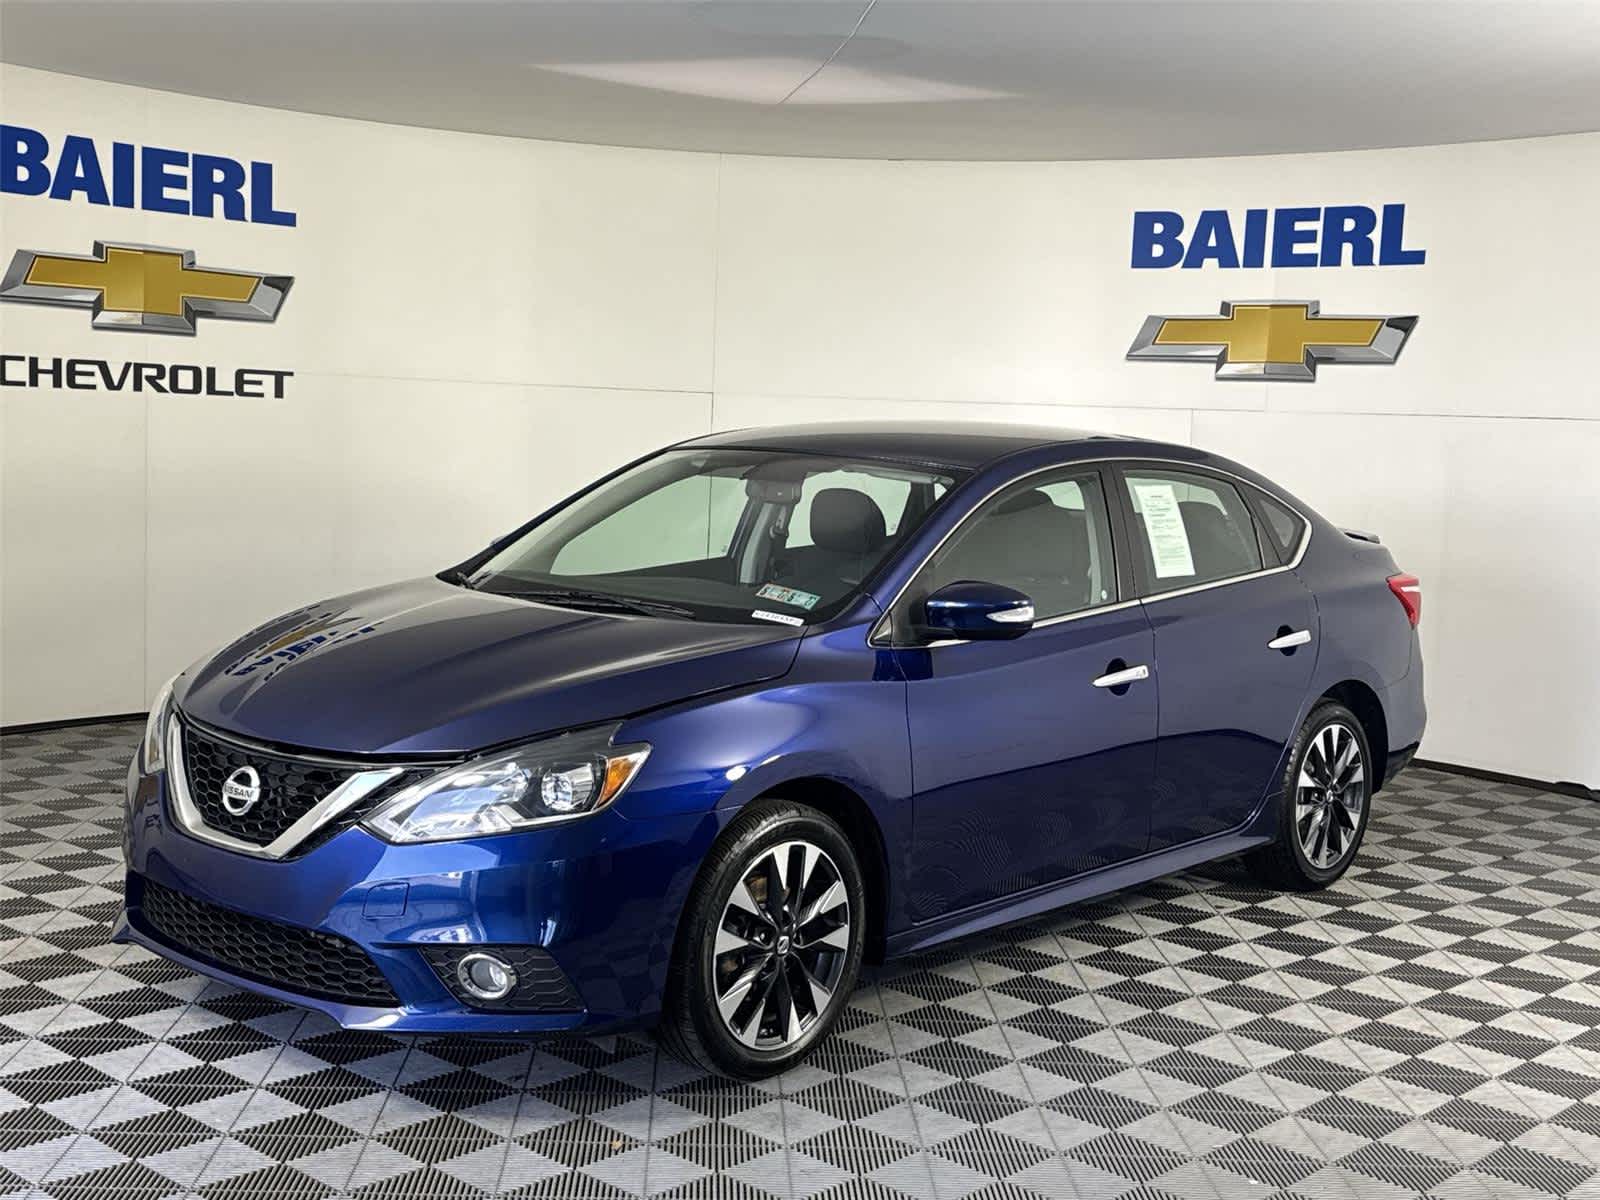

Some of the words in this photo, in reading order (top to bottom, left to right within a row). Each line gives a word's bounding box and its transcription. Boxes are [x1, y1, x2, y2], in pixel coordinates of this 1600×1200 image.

[0, 124, 297, 227] BAIERL
[1131, 203, 1426, 269] BAIERL
[0, 354, 294, 399] CHEVROLET
[224, 783, 255, 799] NISSAN
